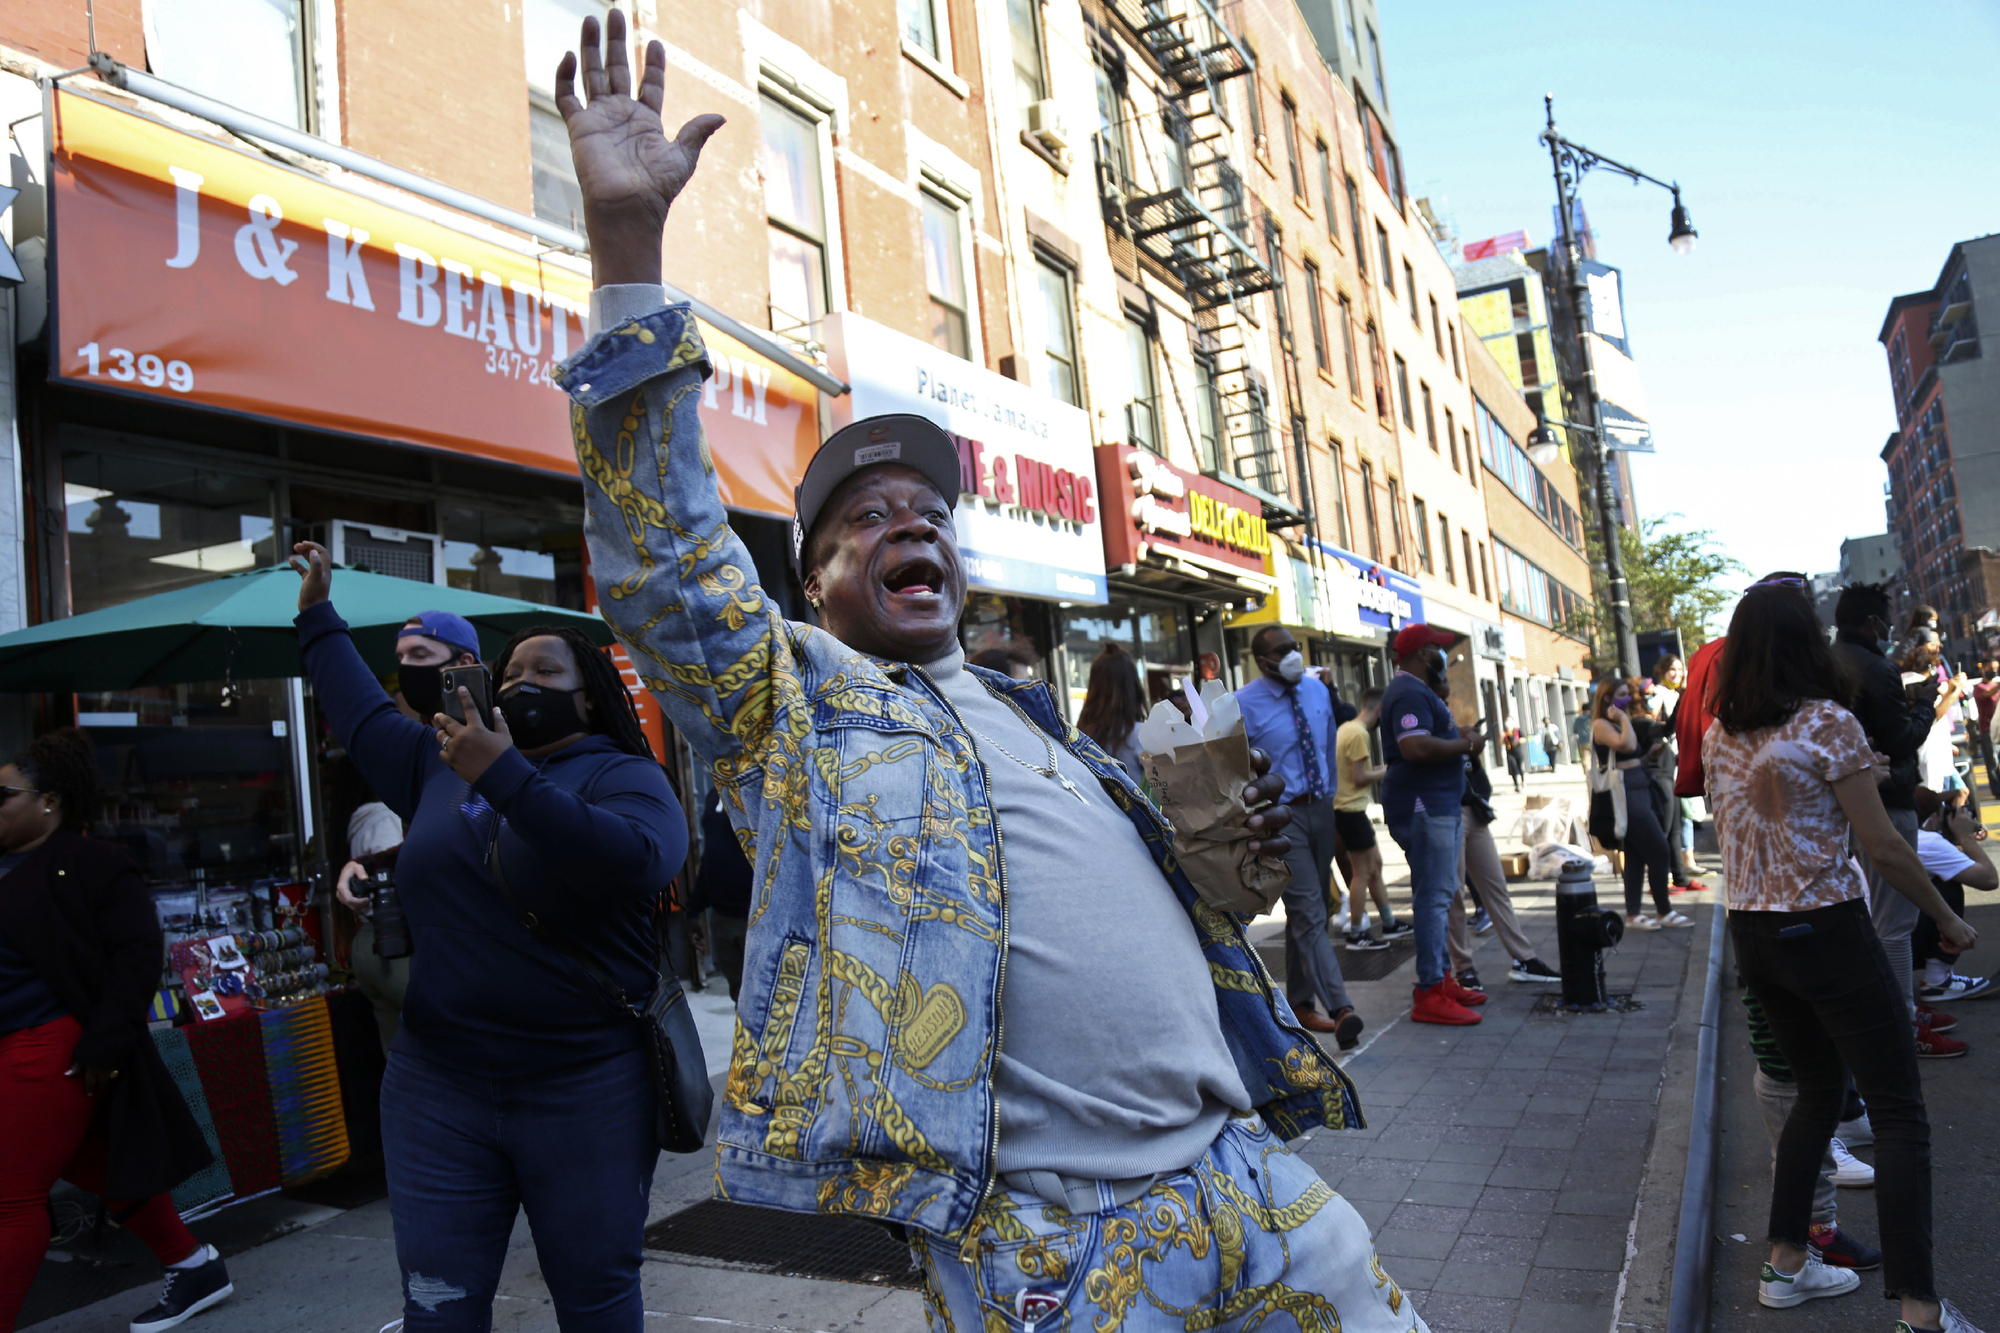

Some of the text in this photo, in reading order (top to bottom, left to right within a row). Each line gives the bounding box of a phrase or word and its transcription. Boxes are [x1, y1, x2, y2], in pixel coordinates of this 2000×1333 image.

[166, 164, 204, 269] J
[234, 193, 299, 287] &
[322, 216, 376, 312] K
[77, 341, 195, 393] 1399
[916, 365, 978, 414] Planet
[993, 454, 1016, 505] &
[1014, 453, 1096, 525] MUSIC
[908, 1000, 954, 1055] REASON
